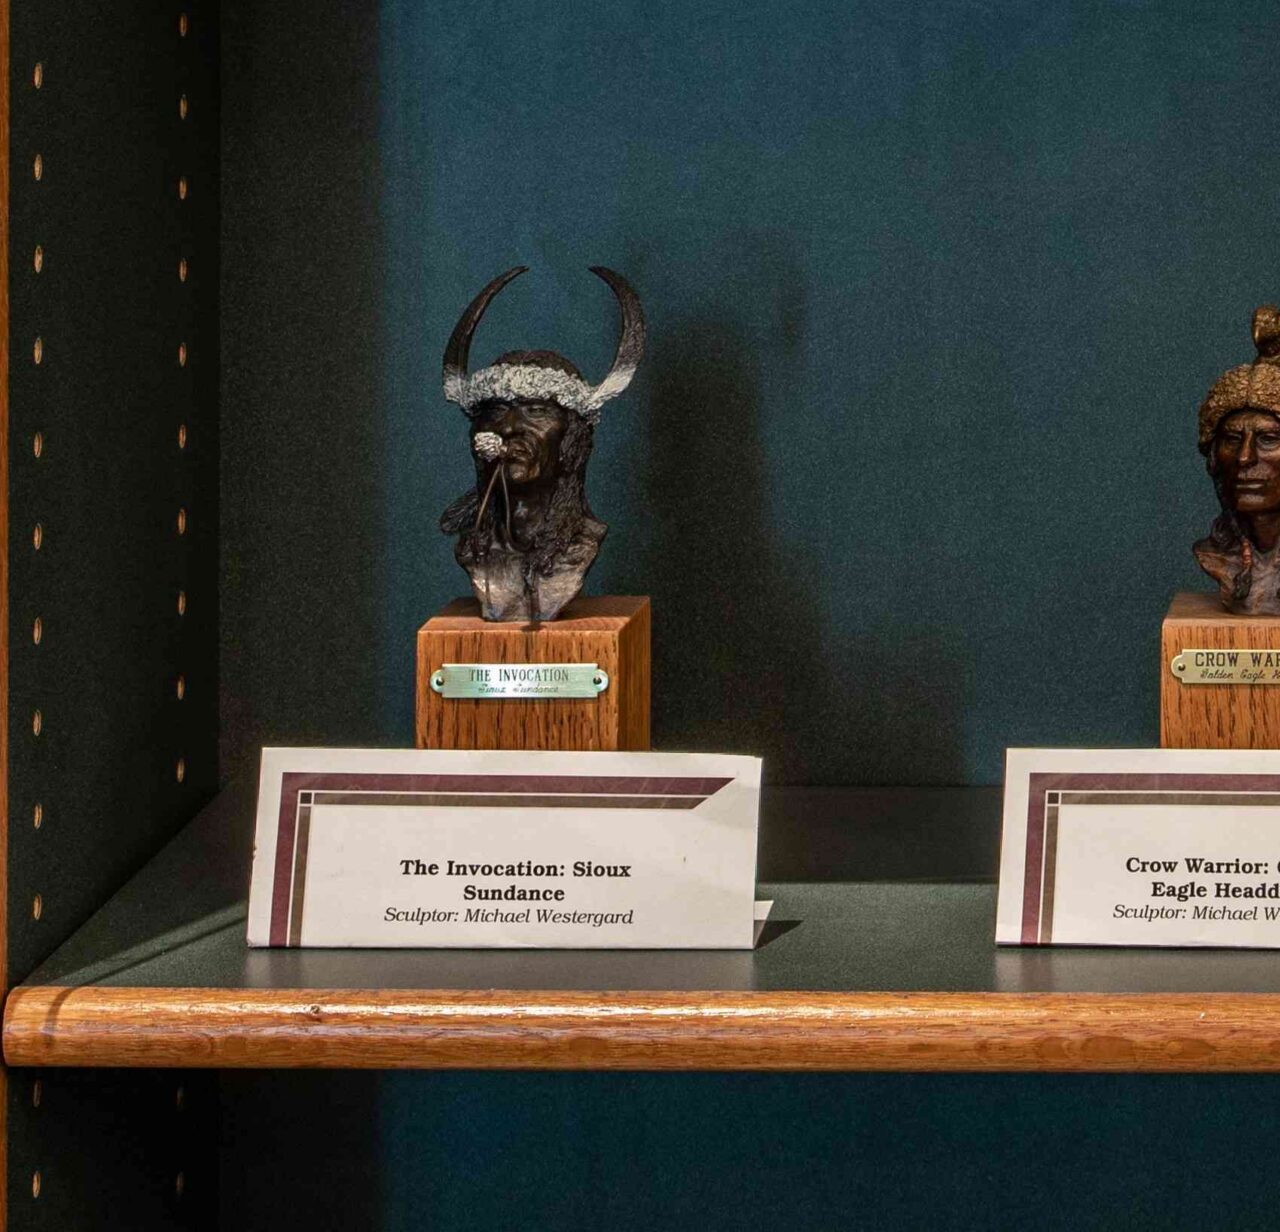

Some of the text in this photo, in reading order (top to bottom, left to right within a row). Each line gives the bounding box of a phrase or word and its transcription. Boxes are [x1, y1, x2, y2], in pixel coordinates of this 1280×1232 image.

[1195, 652, 1240, 668] CROW
[470, 668, 570, 682] THE INVOCATION
[399, 859, 632, 878] The Invocation: Sioux
[1125, 856, 1179, 873] Crow
[1184, 857, 1270, 875] Warrior:
[463, 884, 566, 902] Sundance
[1150, 881, 1208, 902] Eagle
[383, 906, 634, 928] Sculptor: Michael Westergard
[1112, 904, 1187, 923] Sculptor:
[1192, 905, 1258, 921] Michael
